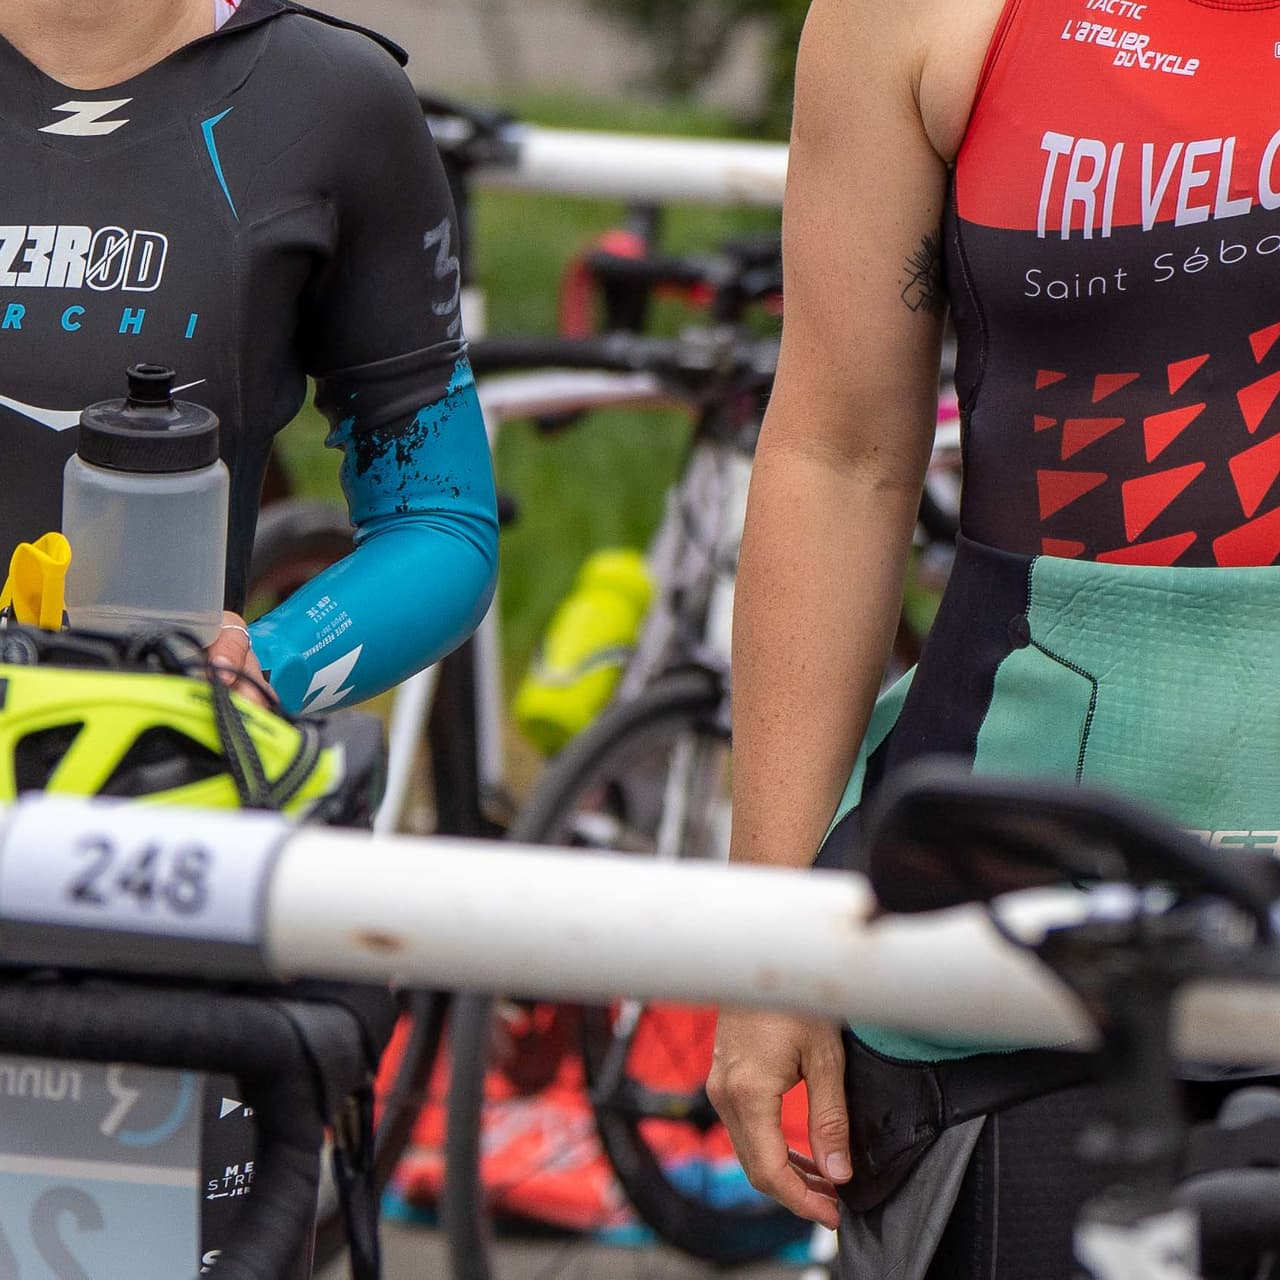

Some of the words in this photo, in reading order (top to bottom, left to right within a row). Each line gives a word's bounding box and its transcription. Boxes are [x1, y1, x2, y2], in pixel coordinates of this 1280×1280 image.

[1112, 50, 1137, 68] DU
[1036, 130, 1124, 241] TRI
[1024, 267, 1129, 300] Saint
[66, 832, 216, 916] 248
